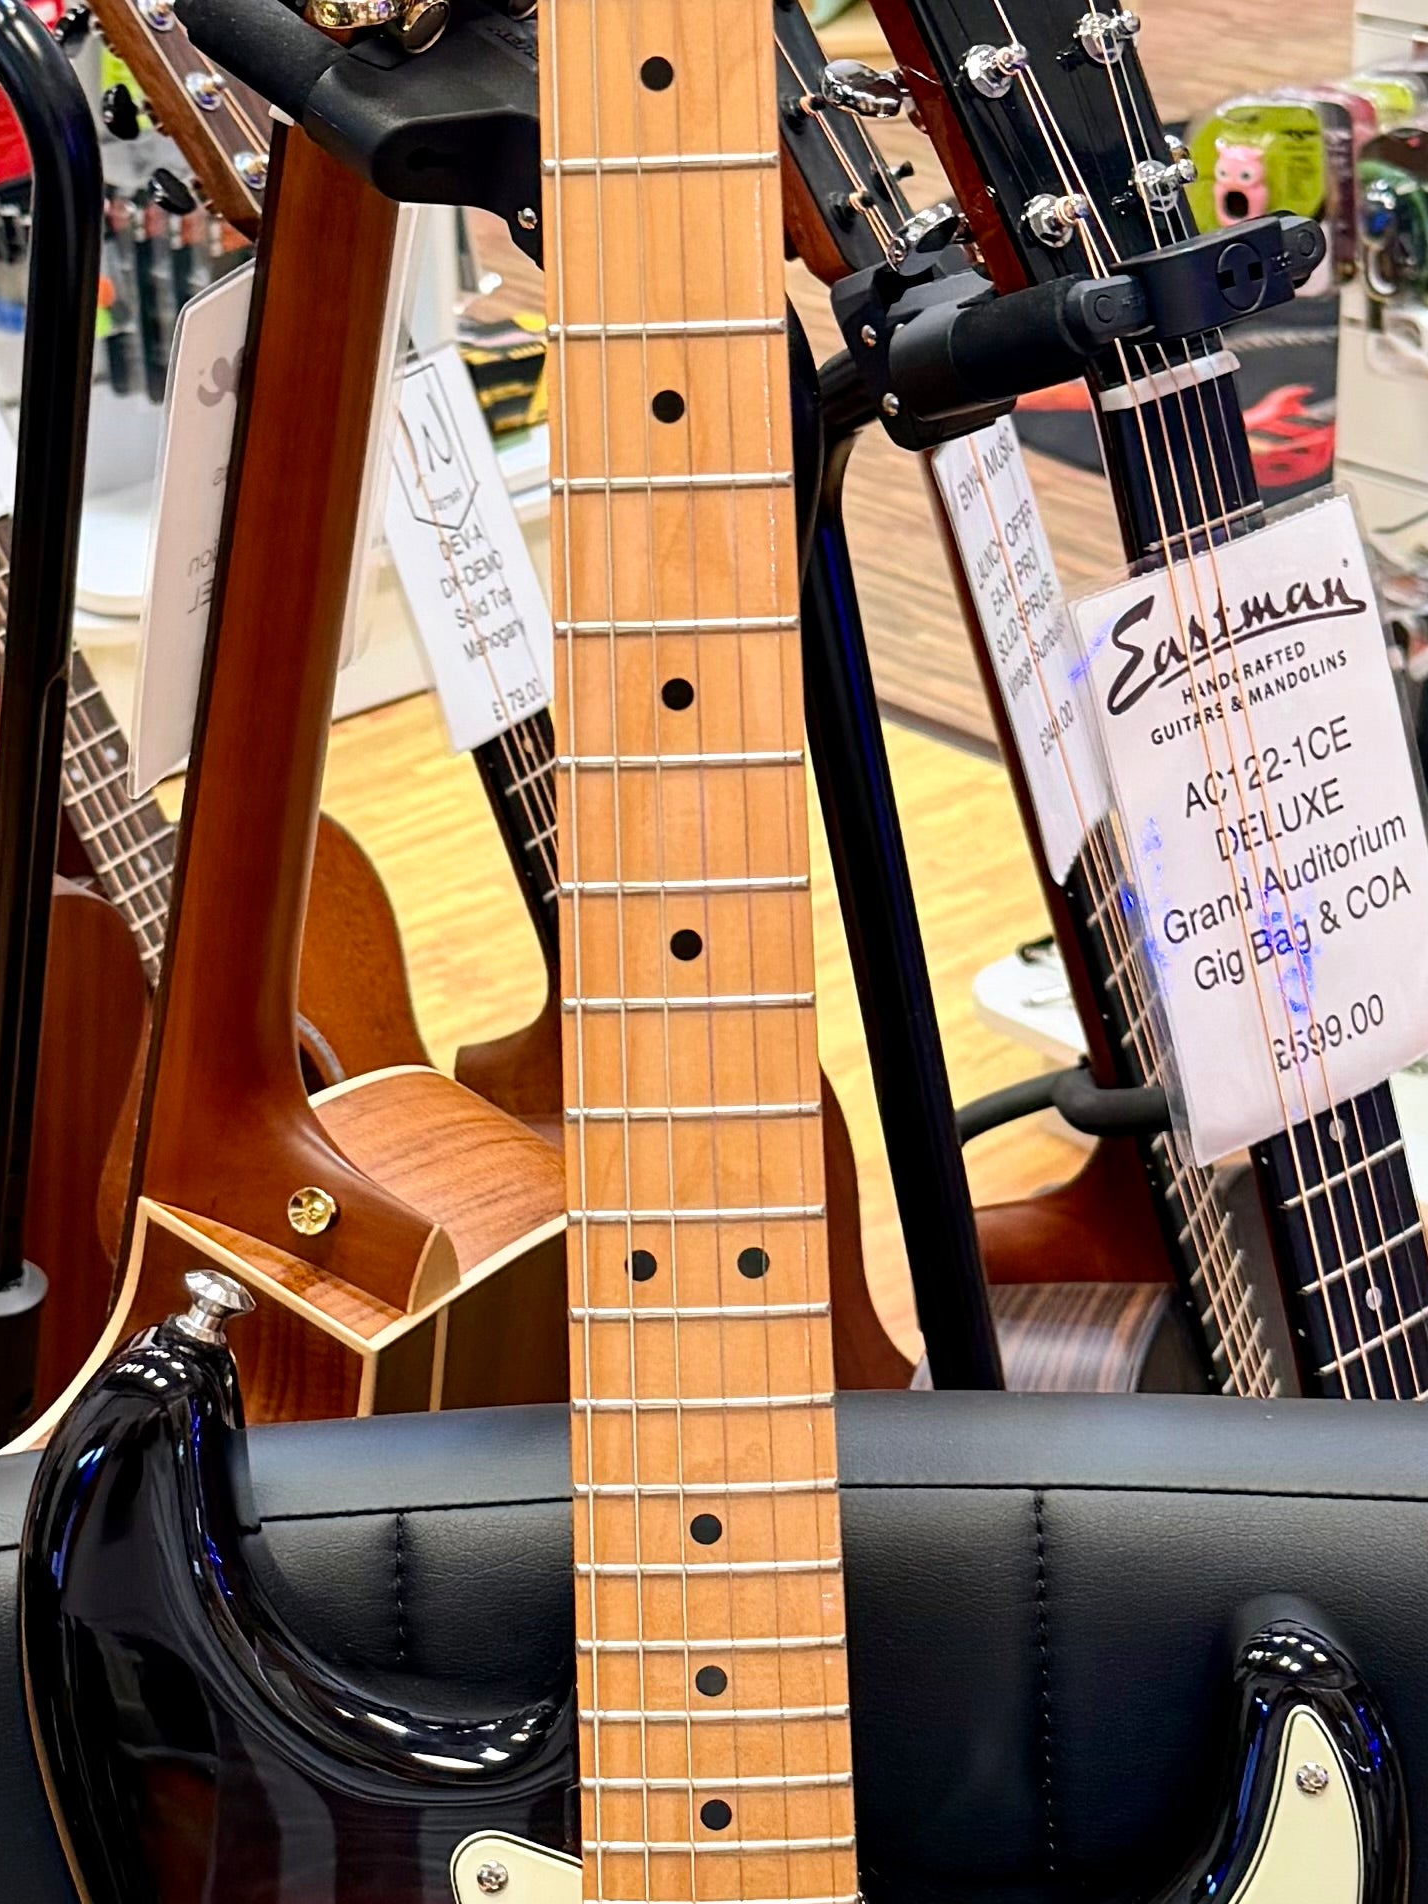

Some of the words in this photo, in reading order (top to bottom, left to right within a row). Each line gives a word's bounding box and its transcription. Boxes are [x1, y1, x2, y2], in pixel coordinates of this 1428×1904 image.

[1107, 577, 1368, 716] Eastman
[492, 675, 543, 723] £79.00
[1150, 701, 1224, 746] GUITARS
[1247, 649, 1348, 707] MANDOLINS
[1184, 715, 1353, 818] AC22-1CE
[1214, 777, 1345, 862] DELUXE
[1163, 876, 1254, 945] Grand
[1263, 814, 1407, 898] Auditorium
[1194, 948, 1245, 991] Gig
[1249, 918, 1312, 966] Bag
[1319, 900, 1341, 935] &
[1345, 865, 1412, 921] COA
[1272, 993, 1385, 1072] £599.00
